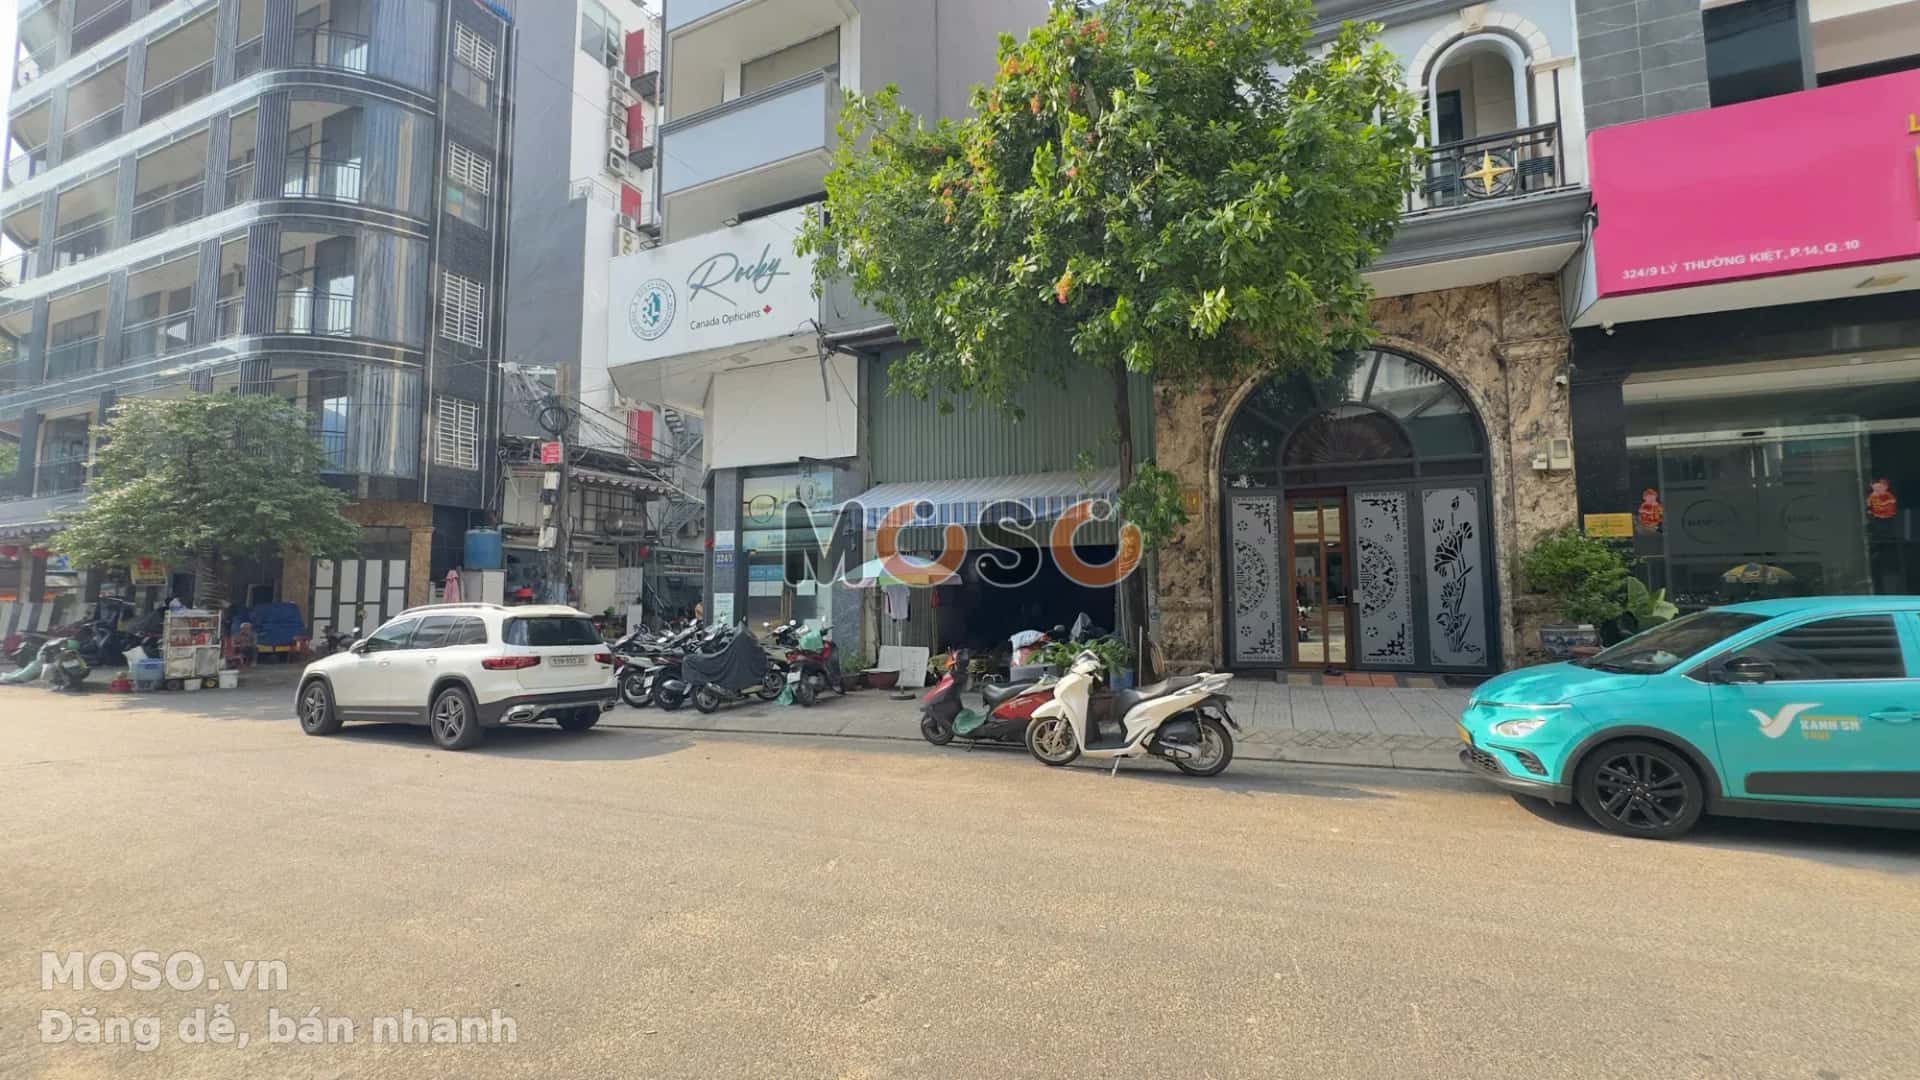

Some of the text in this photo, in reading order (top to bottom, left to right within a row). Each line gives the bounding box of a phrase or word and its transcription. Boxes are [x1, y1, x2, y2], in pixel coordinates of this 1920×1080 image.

[686, 243, 790, 306] Rocky
[1622, 265, 1658, 279] 324/9
[1660, 262, 1678, 275] LÝ
[690, 310, 761, 330] Canada Opticians
[1800, 719, 1839, 731] XANH
